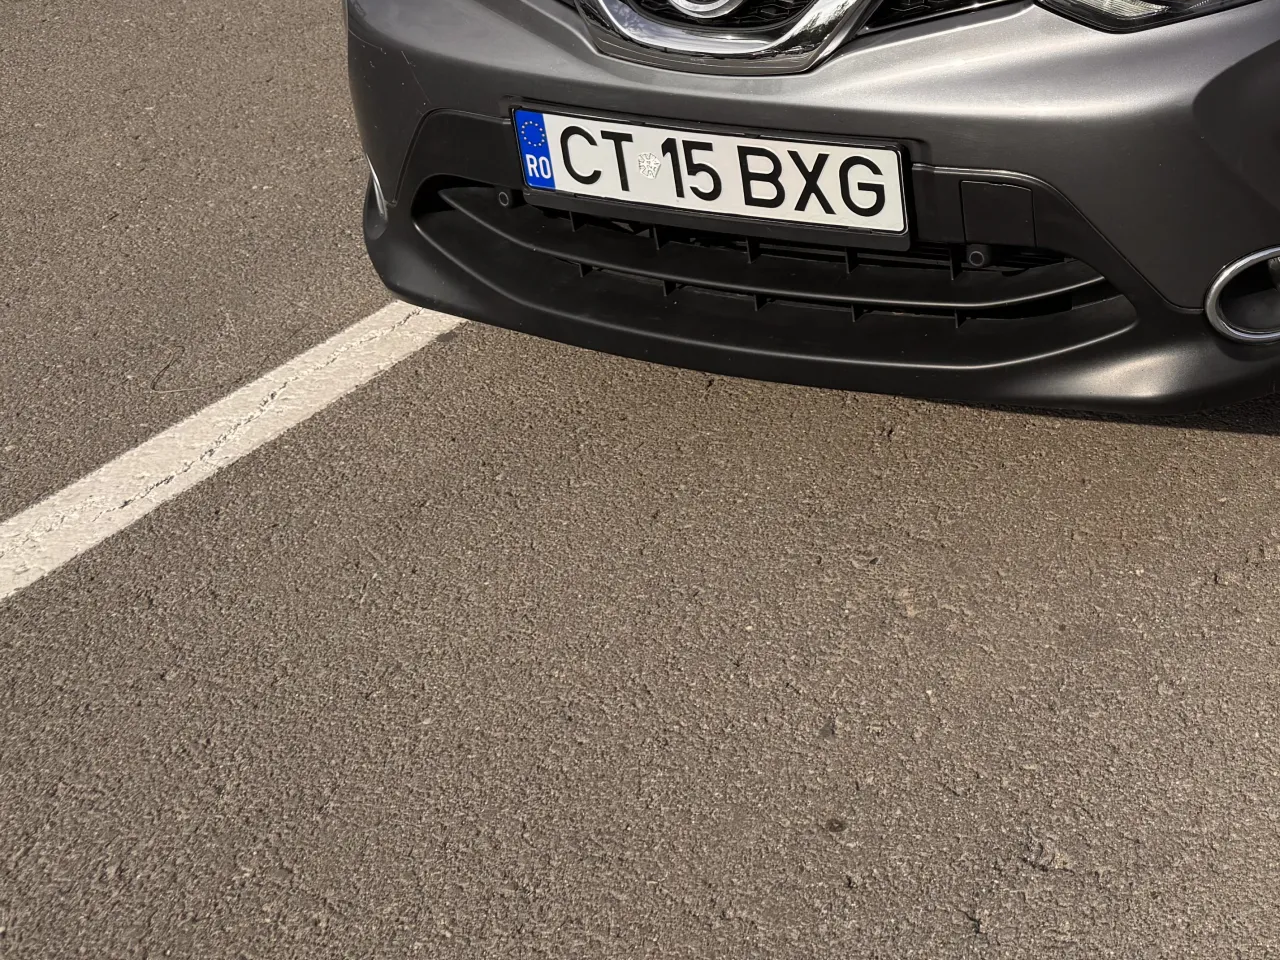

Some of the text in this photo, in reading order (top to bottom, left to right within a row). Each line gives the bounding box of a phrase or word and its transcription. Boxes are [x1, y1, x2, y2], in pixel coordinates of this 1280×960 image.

[525, 153, 552, 179] RO
[560, 125, 885, 217] CT 15 BXG
